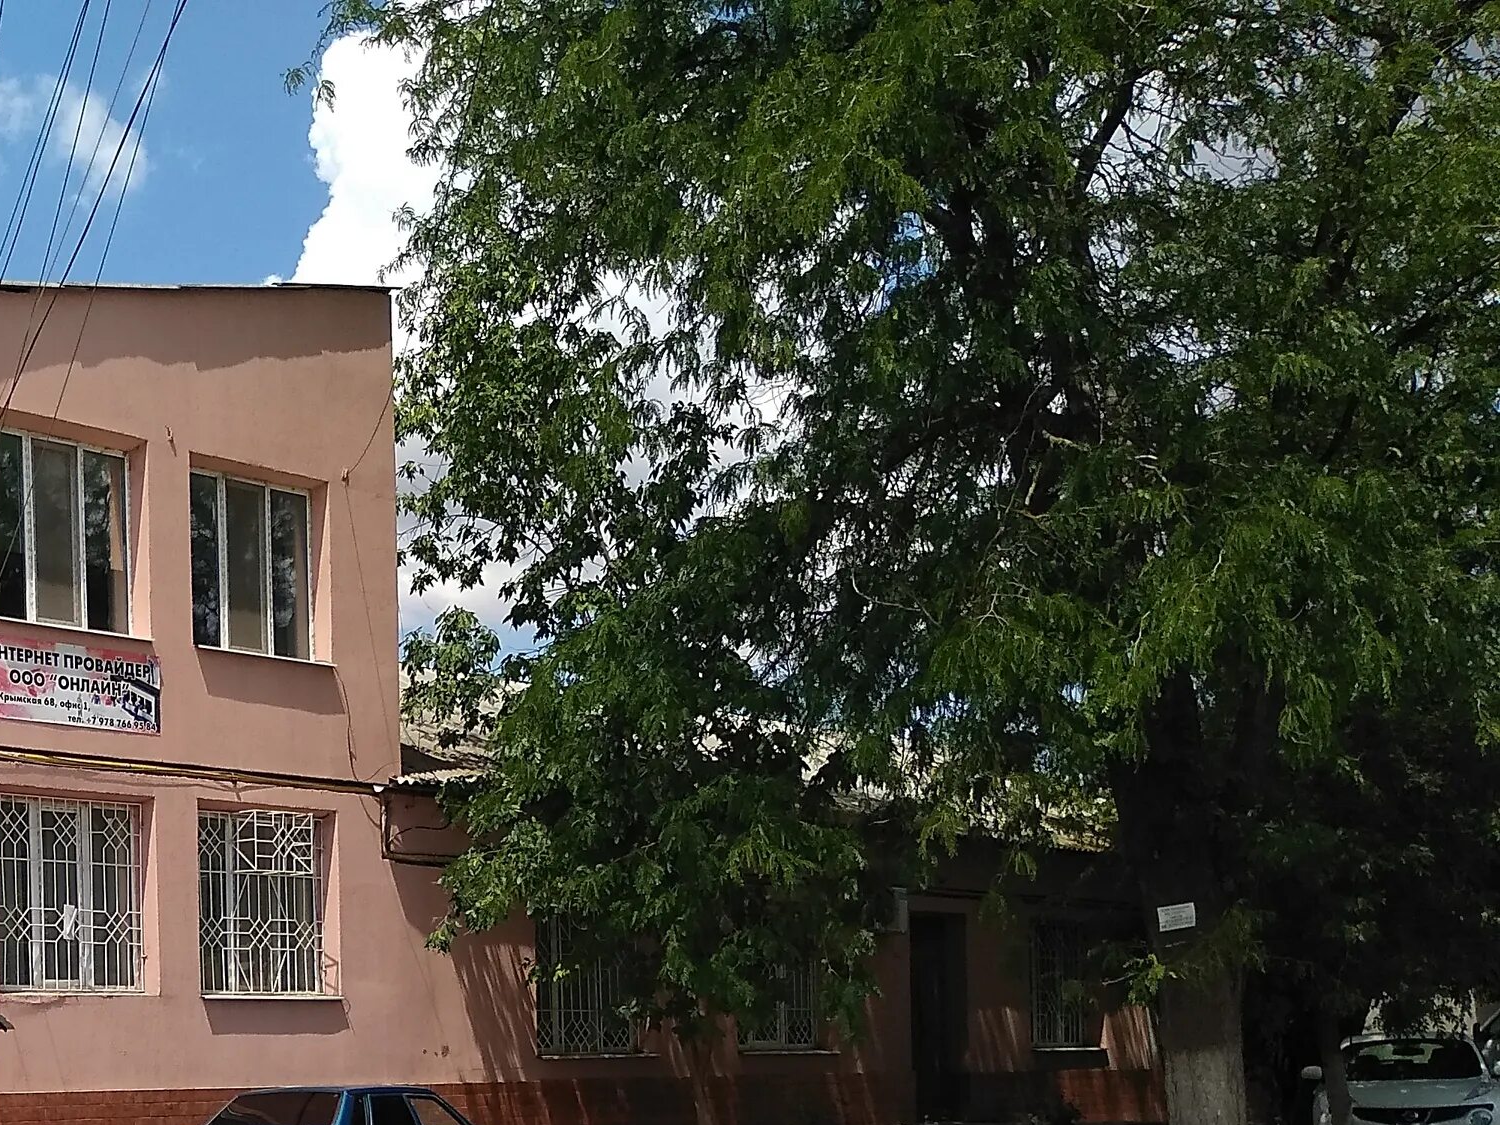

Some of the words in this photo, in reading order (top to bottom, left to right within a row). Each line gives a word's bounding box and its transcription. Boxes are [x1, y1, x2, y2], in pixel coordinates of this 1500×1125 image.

[63, 654, 151, 680] ПРОВАЙДЕР
[9, 669, 45, 687] ООО
[60, 699, 81, 711] офис
[68, 715, 84, 724] тел.
[99, 717, 114, 727] 978
[116, 719, 132, 729] 766
[133, 720, 144, 730] 95
